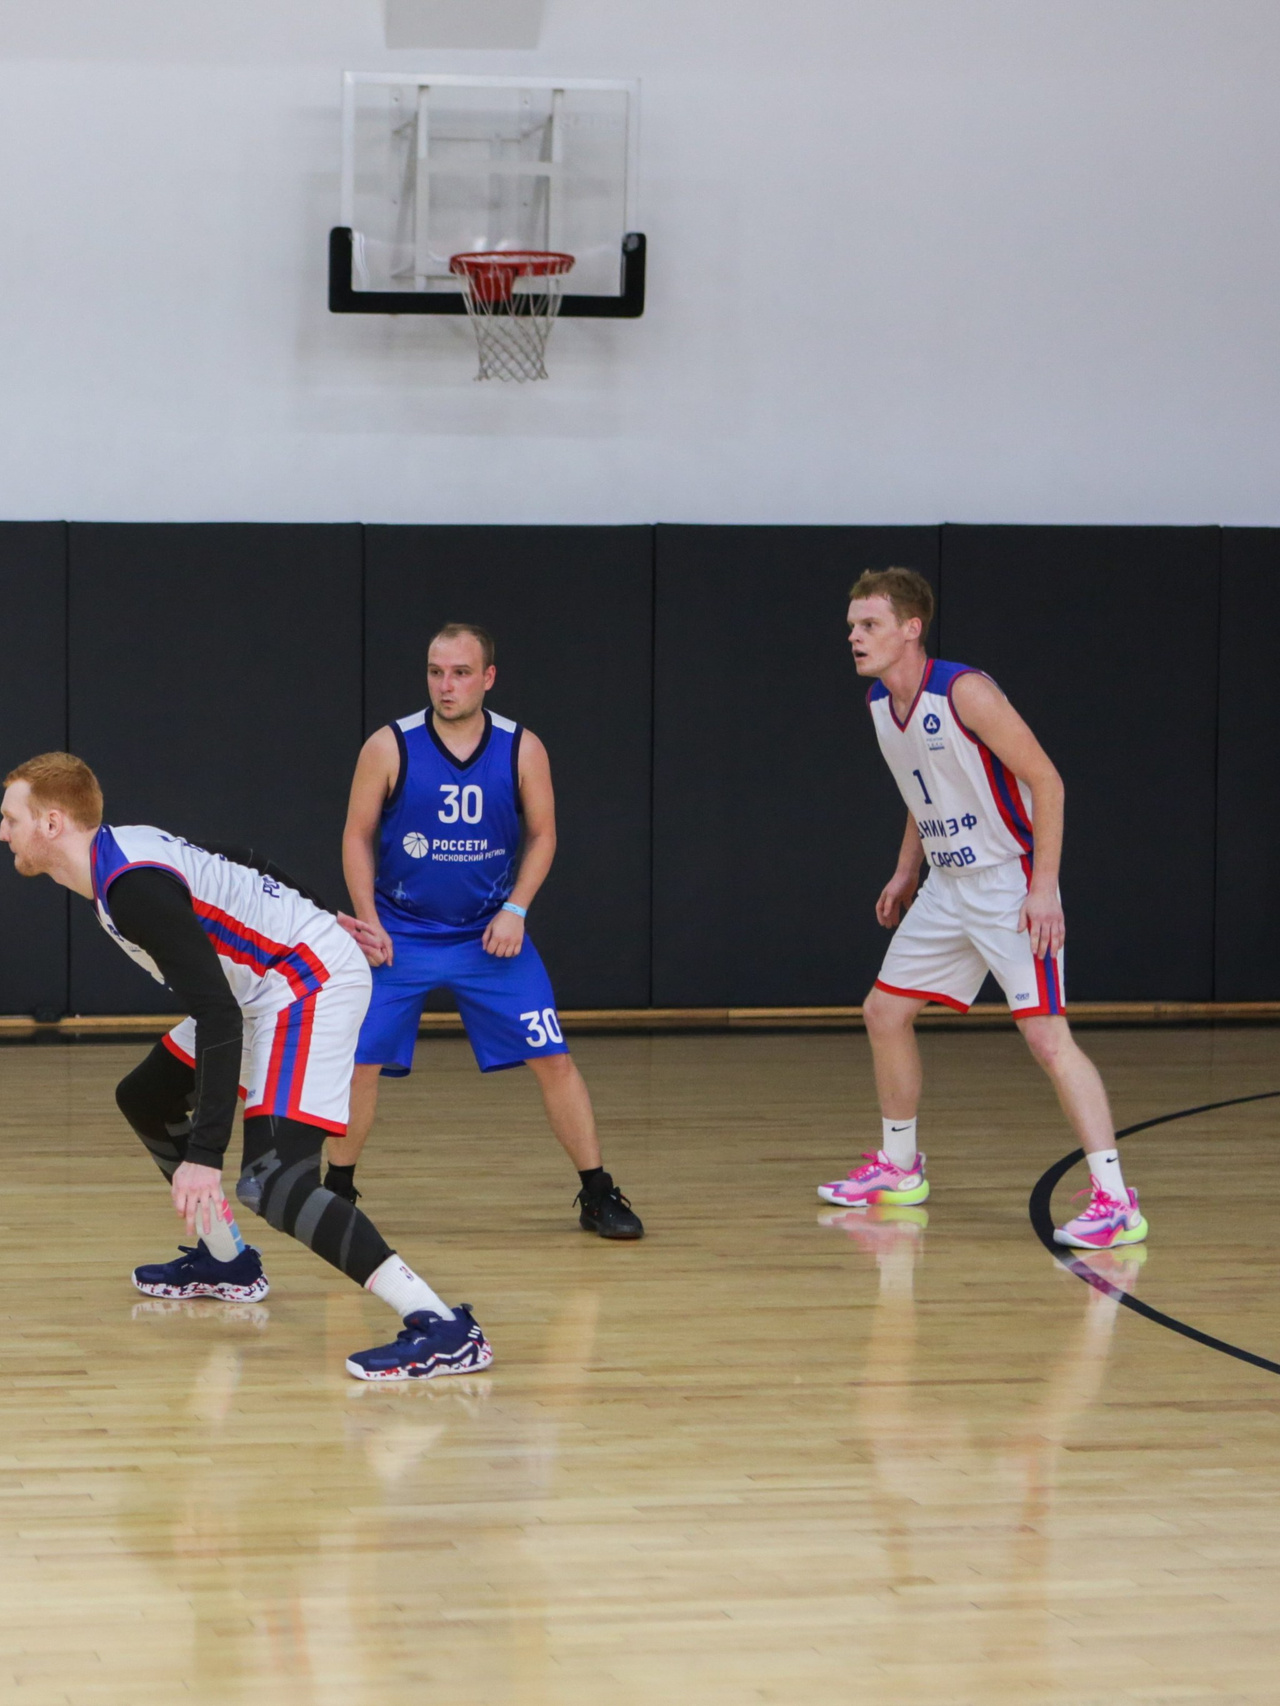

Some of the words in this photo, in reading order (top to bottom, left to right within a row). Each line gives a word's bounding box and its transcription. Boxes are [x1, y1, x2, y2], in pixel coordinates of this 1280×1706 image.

[912, 769, 932, 804] 1
[438, 784, 483, 824] 30
[432, 839, 488, 851] РОССЕТИ
[432, 852, 484, 862] МОСКОВСКИЙ
[484, 848, 506, 860] РЕГИОН
[931, 846, 976, 868] САРОВ
[519, 1007, 564, 1048] 30
